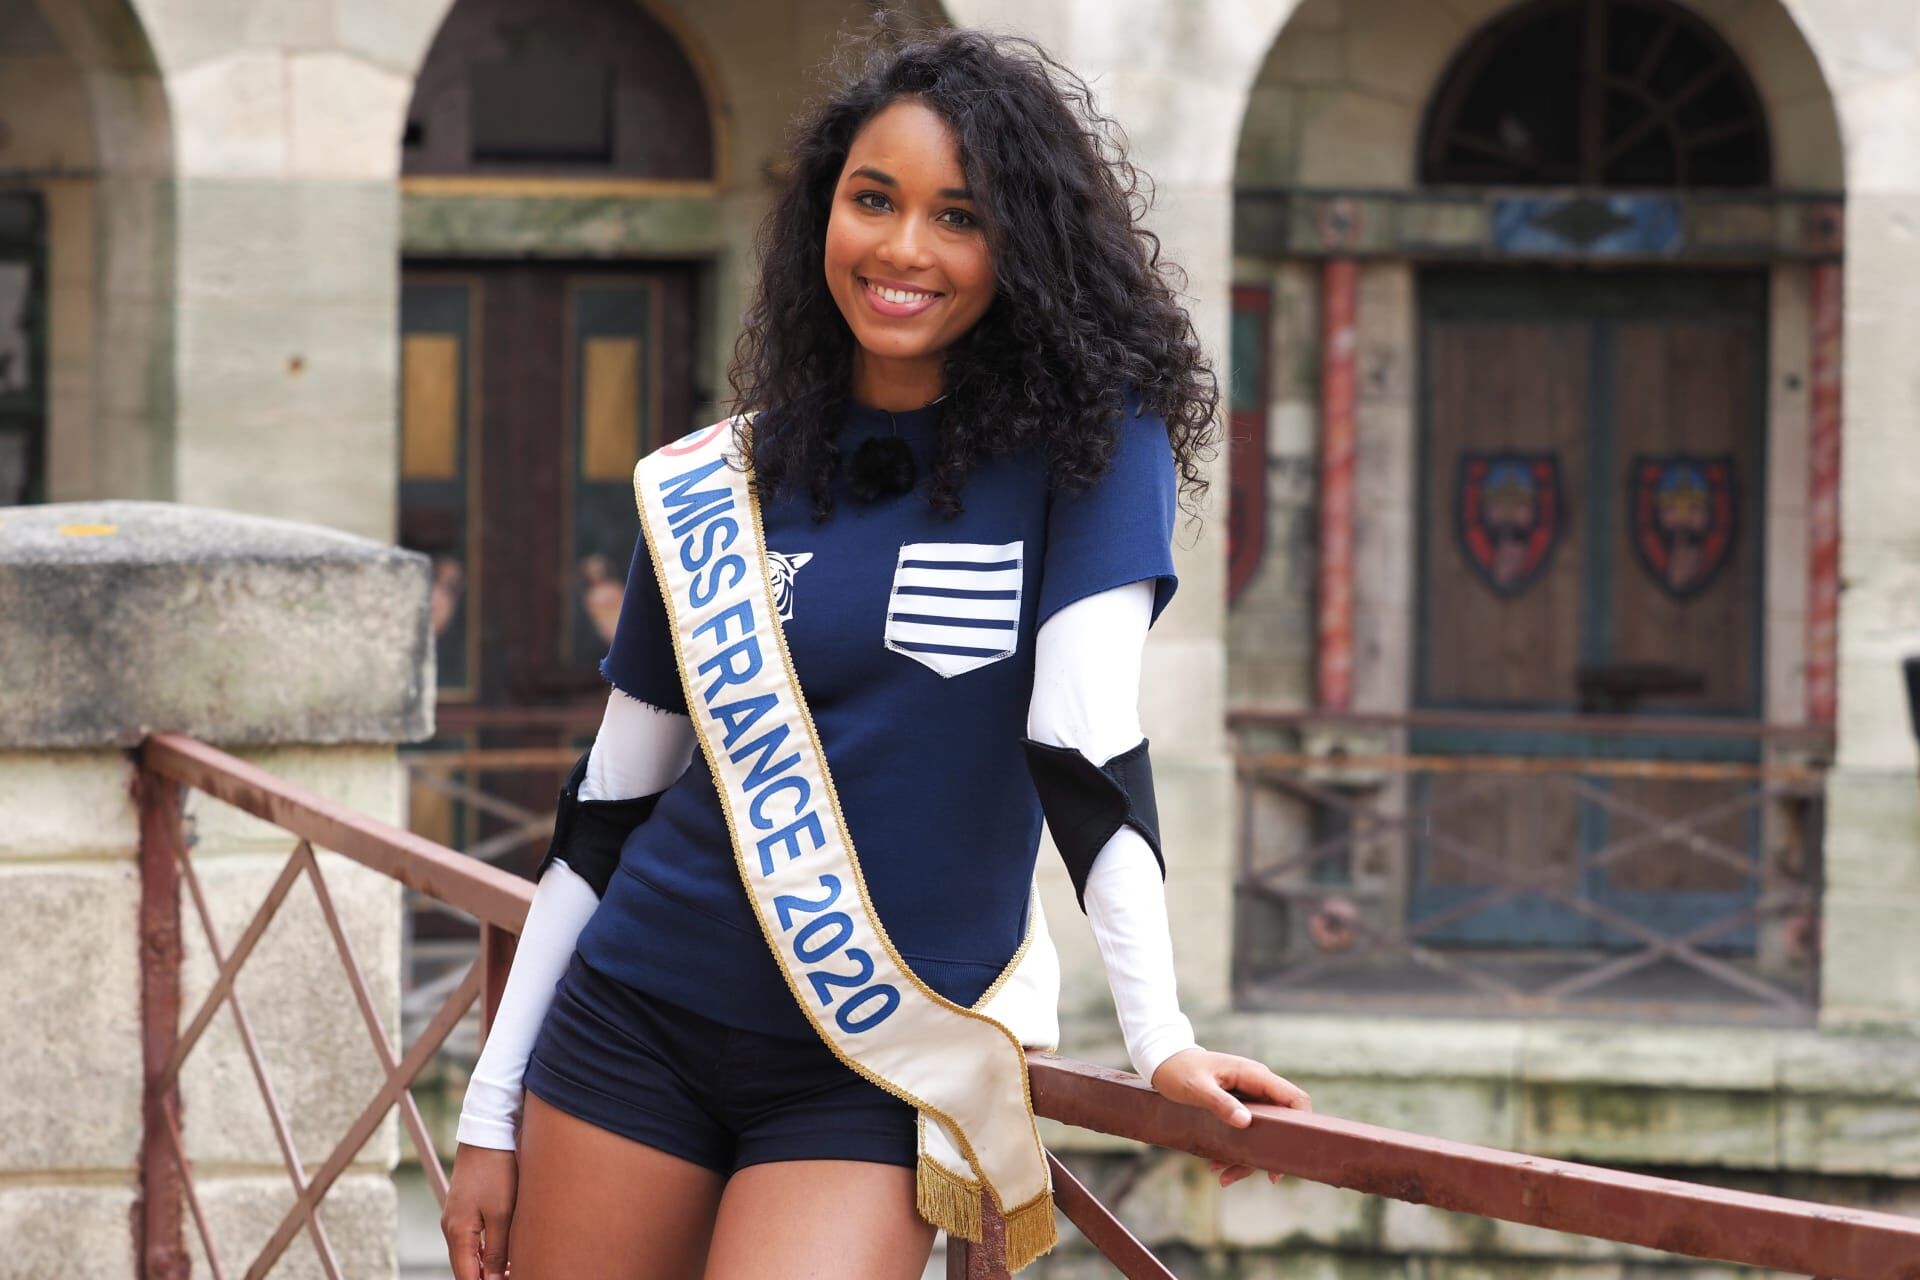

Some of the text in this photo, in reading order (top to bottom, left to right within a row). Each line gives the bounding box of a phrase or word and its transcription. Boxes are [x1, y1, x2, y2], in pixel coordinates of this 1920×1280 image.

[659, 457, 901, 1034] MISS FRANCE 2020
